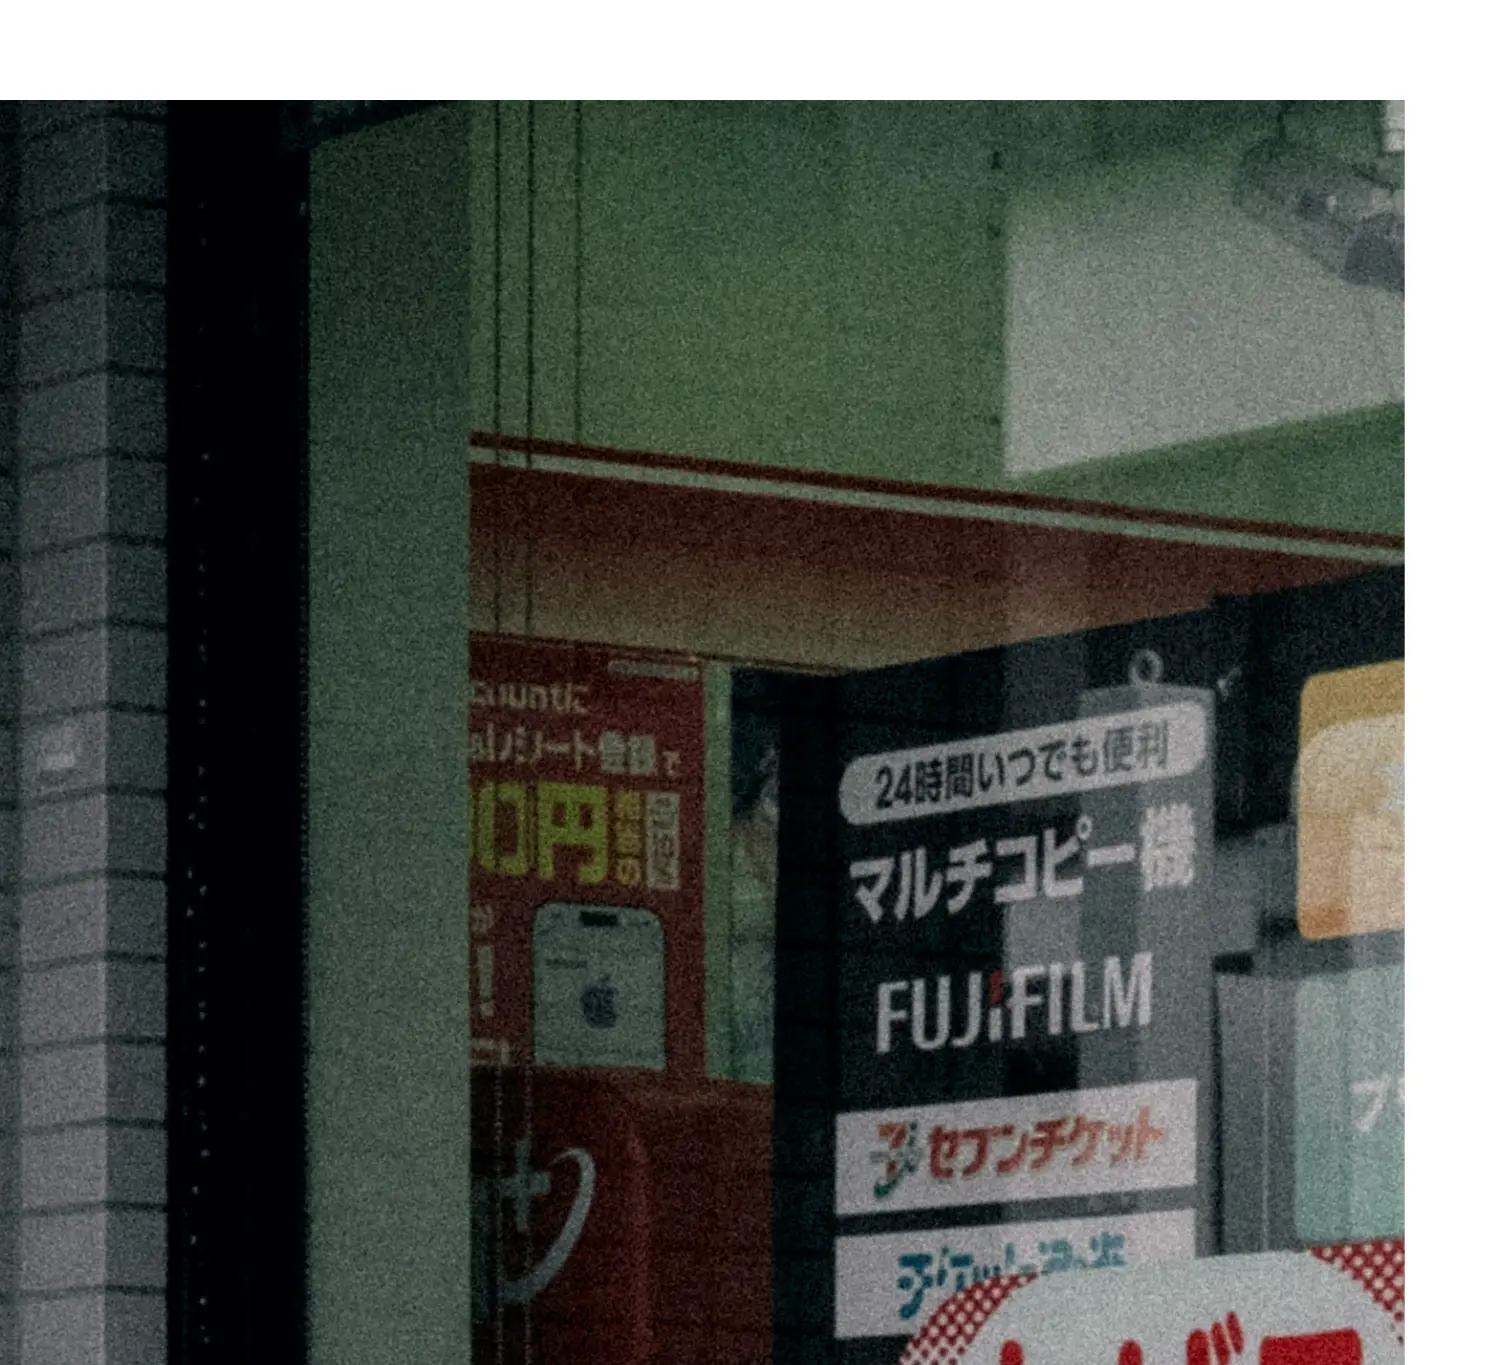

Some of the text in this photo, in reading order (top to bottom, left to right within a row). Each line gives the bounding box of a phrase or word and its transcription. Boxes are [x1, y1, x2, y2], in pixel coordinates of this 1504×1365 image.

[873, 719, 1170, 810] 24時間いつでも便利
[470, 780, 609, 884] 0円
[849, 801, 1196, 925] マルチコピー機
[876, 950, 1153, 1055] FUJIFILM
[927, 1105, 1165, 1181] セブンチケット
